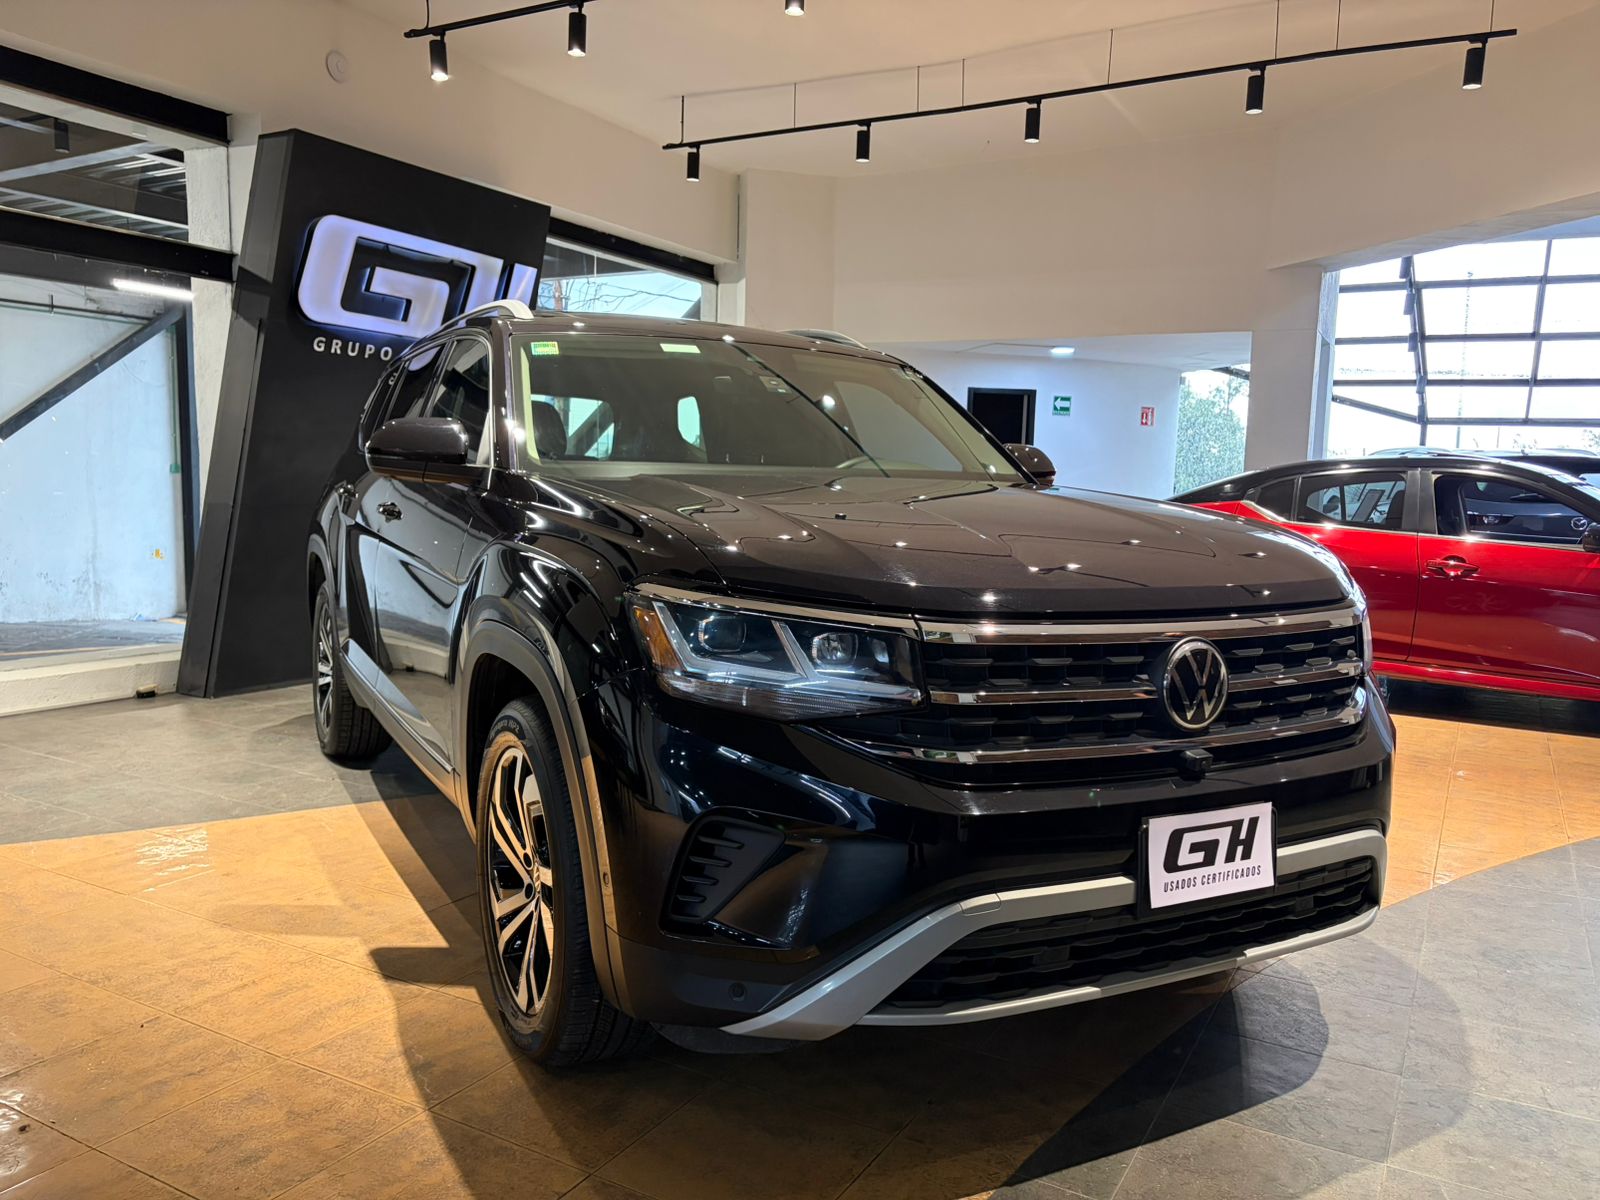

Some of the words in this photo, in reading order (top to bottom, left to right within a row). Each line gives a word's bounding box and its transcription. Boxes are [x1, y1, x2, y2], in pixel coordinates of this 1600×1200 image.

[313, 336, 393, 361] GRUPO
[1163, 816, 1260, 874] GH
[1164, 876, 1197, 893] USADOS
[1201, 865, 1261, 886] CERTIFICADOS
